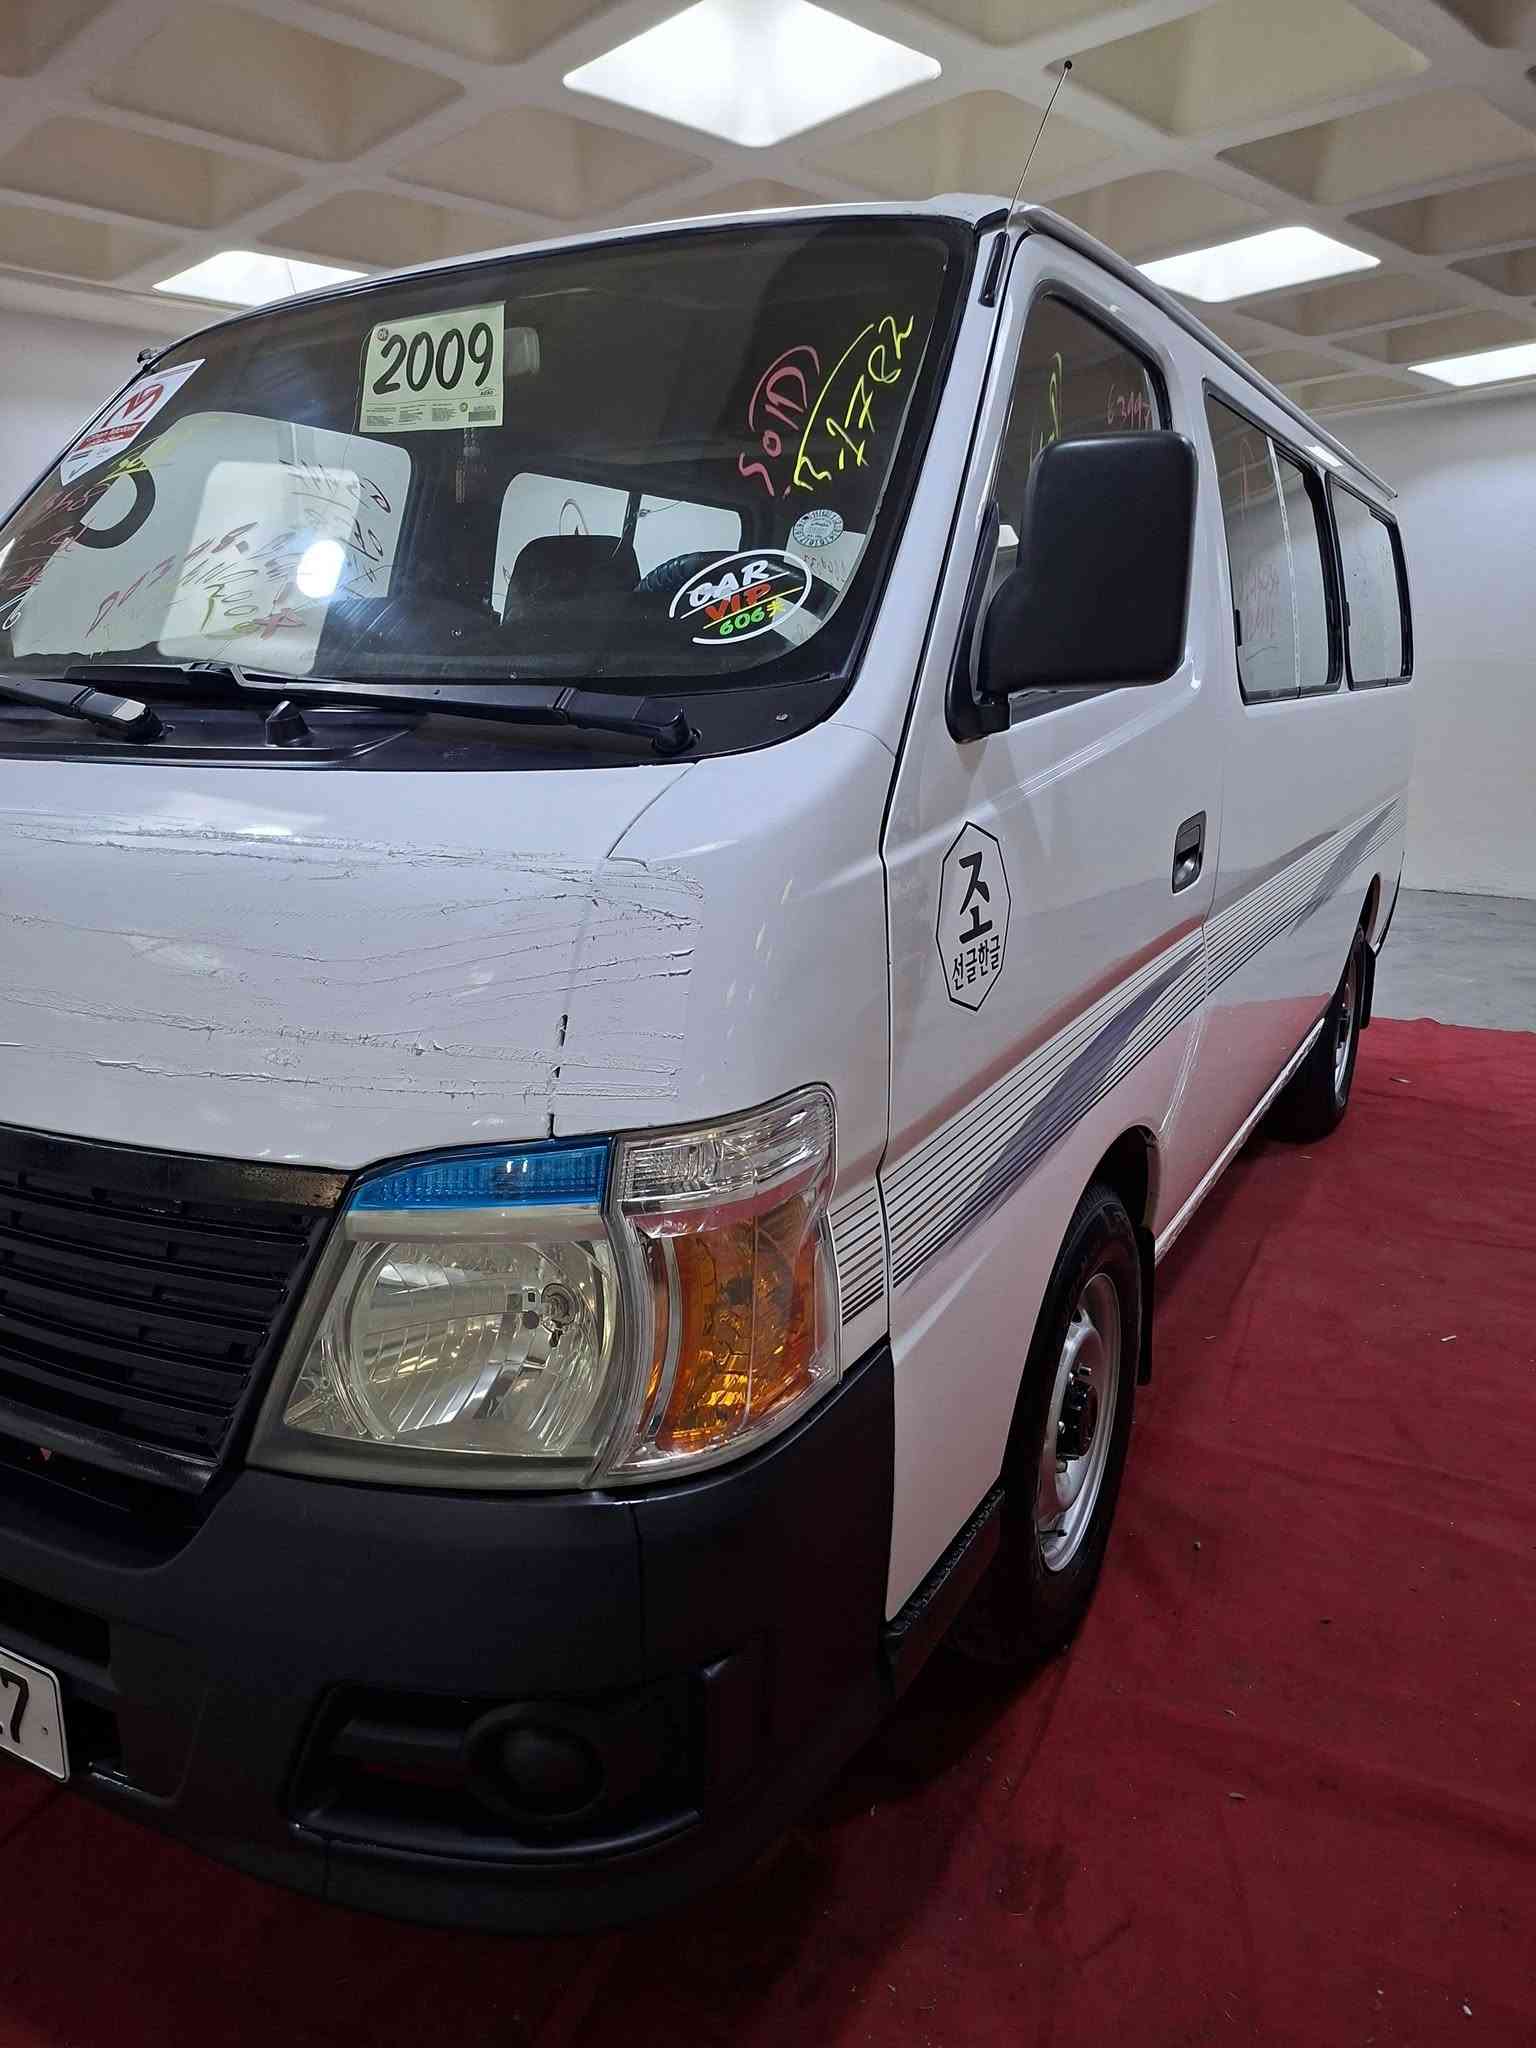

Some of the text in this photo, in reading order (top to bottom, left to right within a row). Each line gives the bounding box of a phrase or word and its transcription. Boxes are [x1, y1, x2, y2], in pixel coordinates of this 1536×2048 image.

[372, 321, 494, 395] 2009
[704, 582, 772, 620] VIP
[958, 851, 993, 944] 조
[951, 934, 1001, 991] 선글한글
[0, 1667, 30, 1744] 7
